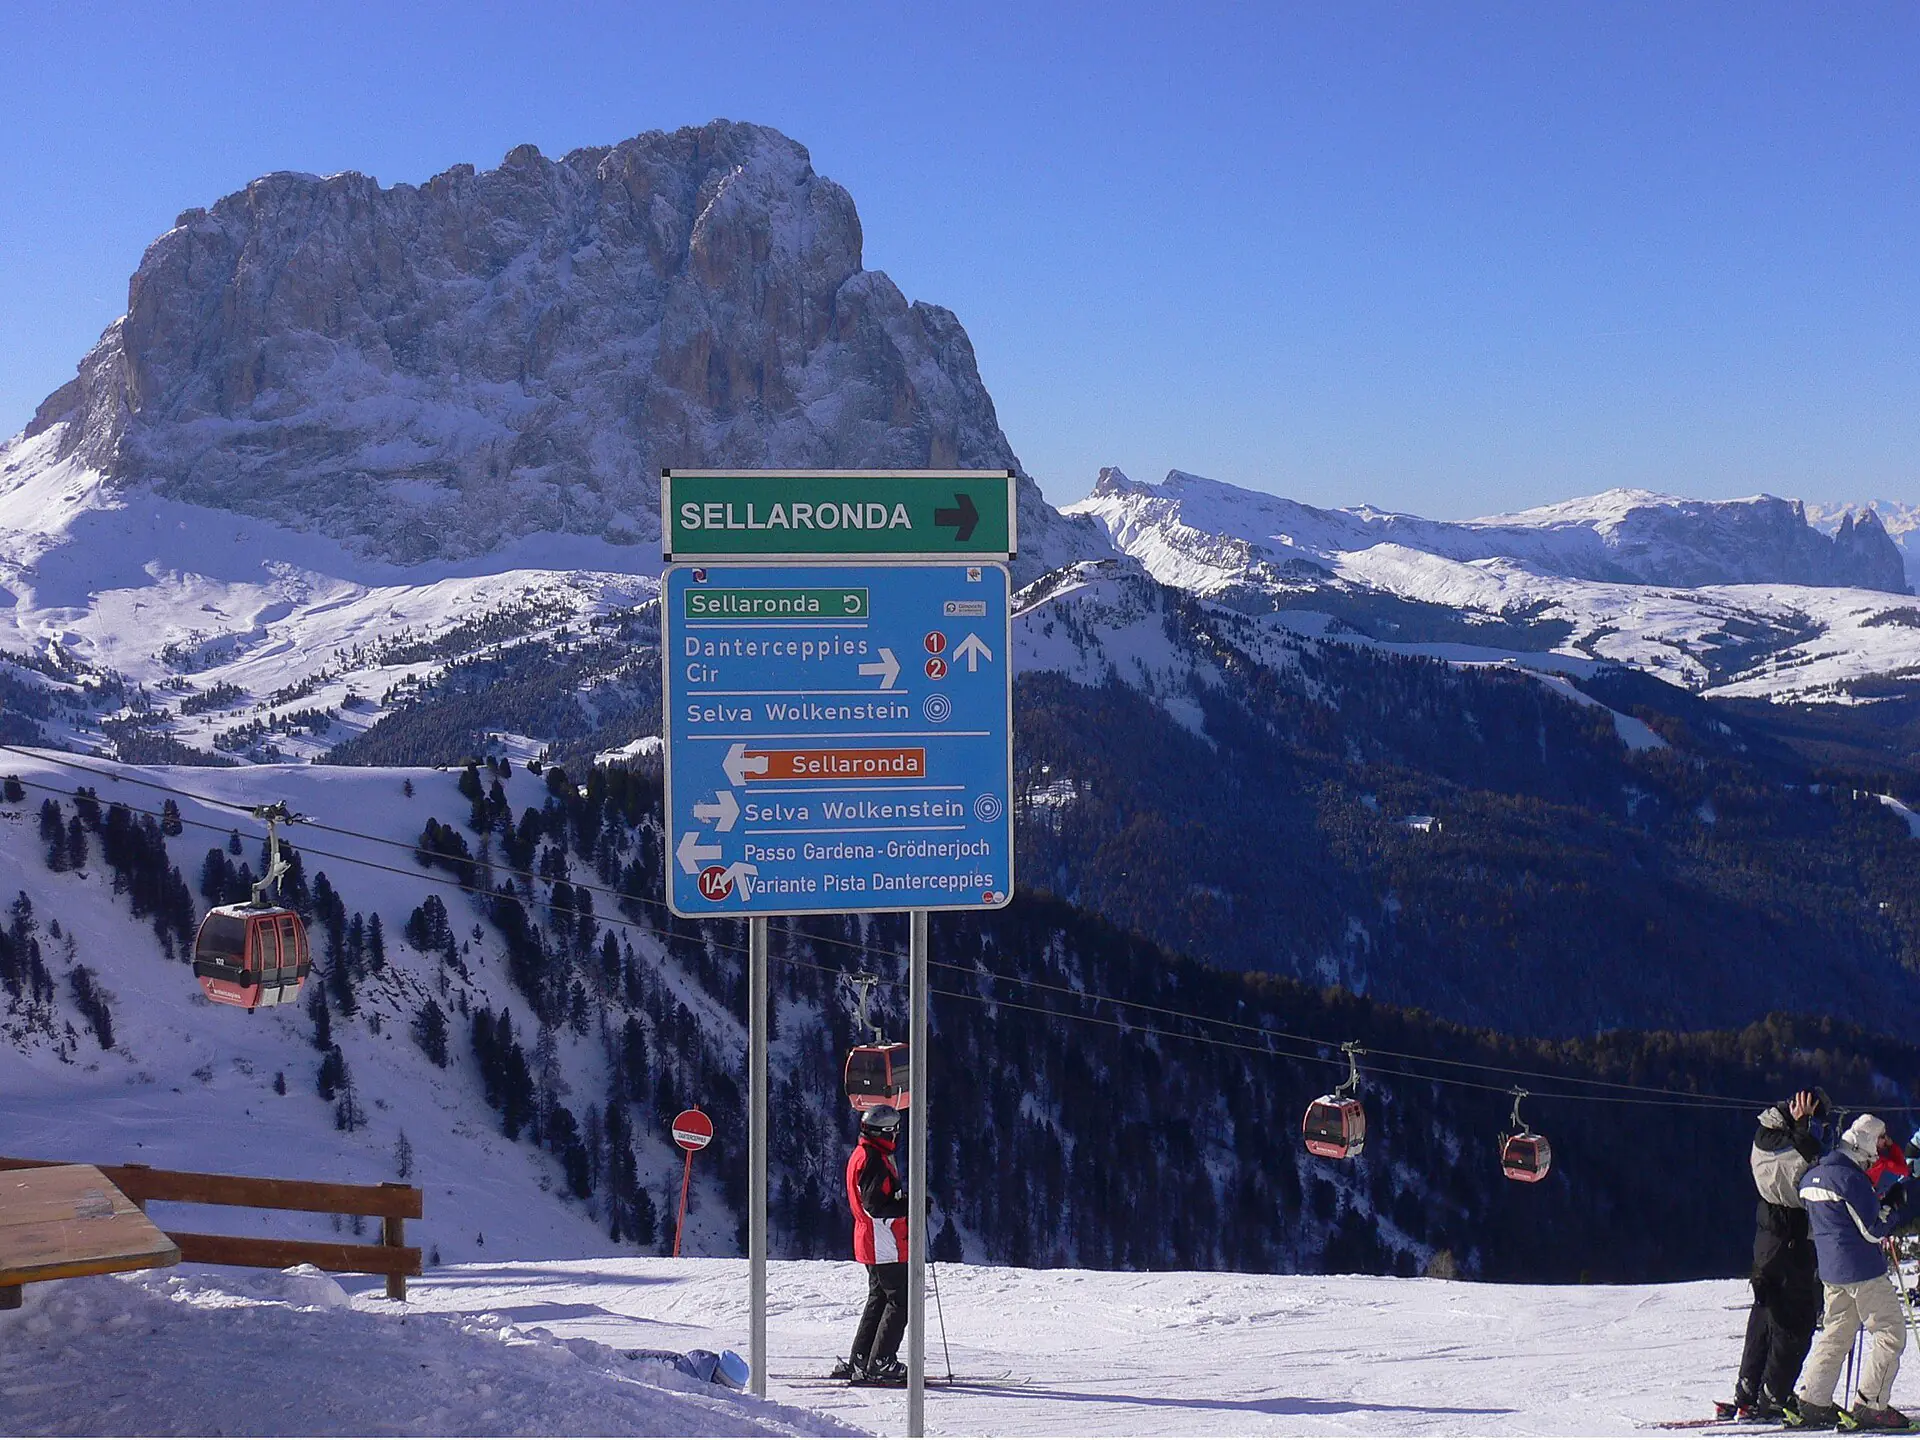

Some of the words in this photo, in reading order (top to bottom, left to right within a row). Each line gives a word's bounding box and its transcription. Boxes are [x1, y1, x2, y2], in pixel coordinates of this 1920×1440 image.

[680, 503, 912, 530] SELLARONDA
[691, 595, 820, 613] Sellaronda
[685, 635, 868, 660] Danterceppies
[929, 633, 939, 652] 1
[686, 663, 719, 682] Cir
[930, 660, 943, 679] 2
[687, 704, 752, 722] Selva
[765, 702, 910, 721] Wolkenstein
[792, 754, 918, 773] Sellaronda
[744, 803, 809, 822] Selva
[822, 801, 964, 819] Wolkenstein
[744, 844, 796, 862] Passo
[703, 872, 727, 894] 1A
[746, 875, 817, 894] Variante
[823, 873, 866, 892] Pista
[872, 869, 993, 894] Danterceppies
